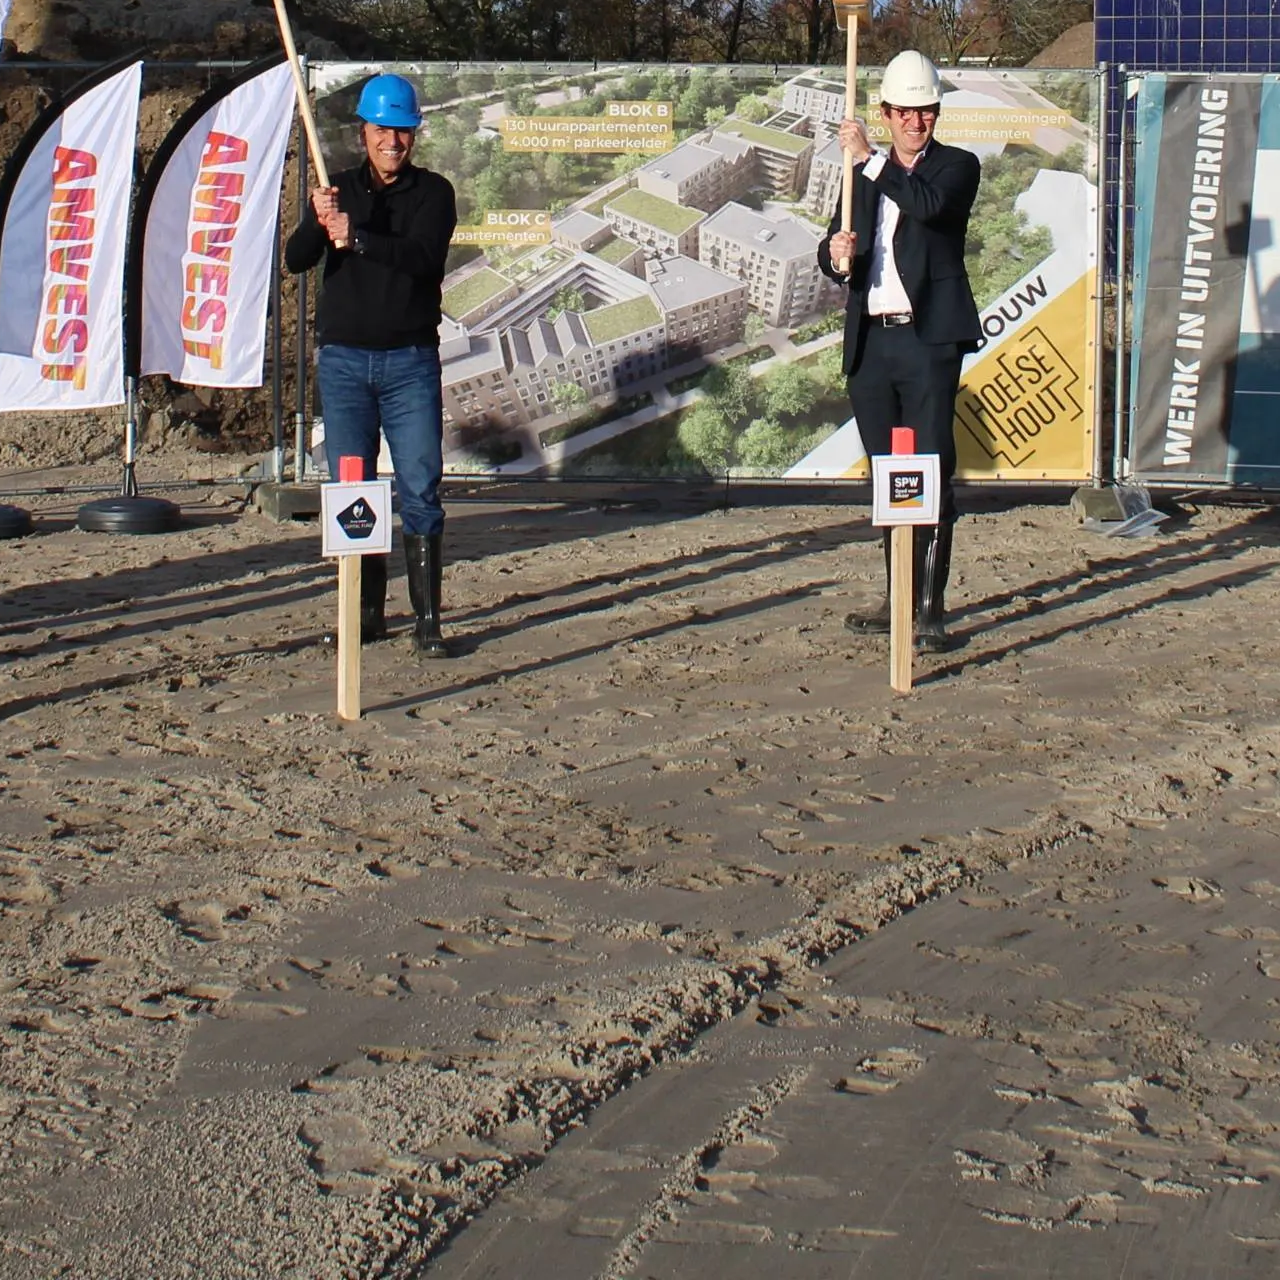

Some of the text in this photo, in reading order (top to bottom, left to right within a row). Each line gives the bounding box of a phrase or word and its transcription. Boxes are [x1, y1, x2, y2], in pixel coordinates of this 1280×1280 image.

[609, 104, 669, 117] BLOK B
[1000, 112, 1066, 126] woningen
[505, 120, 668, 134] 130 huurappartementen
[868, 127, 885, 137] 20
[510, 136, 549, 147] 4.000
[574, 137, 668, 150] parkeerkelder
[487, 213, 546, 225] BLOK C
[181, 130, 248, 369] AMVEST
[41, 146, 97, 390] AMVEST
[1163, 88, 1229, 466] WERK IN UITVOERING
[964, 344, 1055, 442] HOEFSE
[996, 375, 1066, 450] HOUT
[894, 476, 919, 488] SPW
